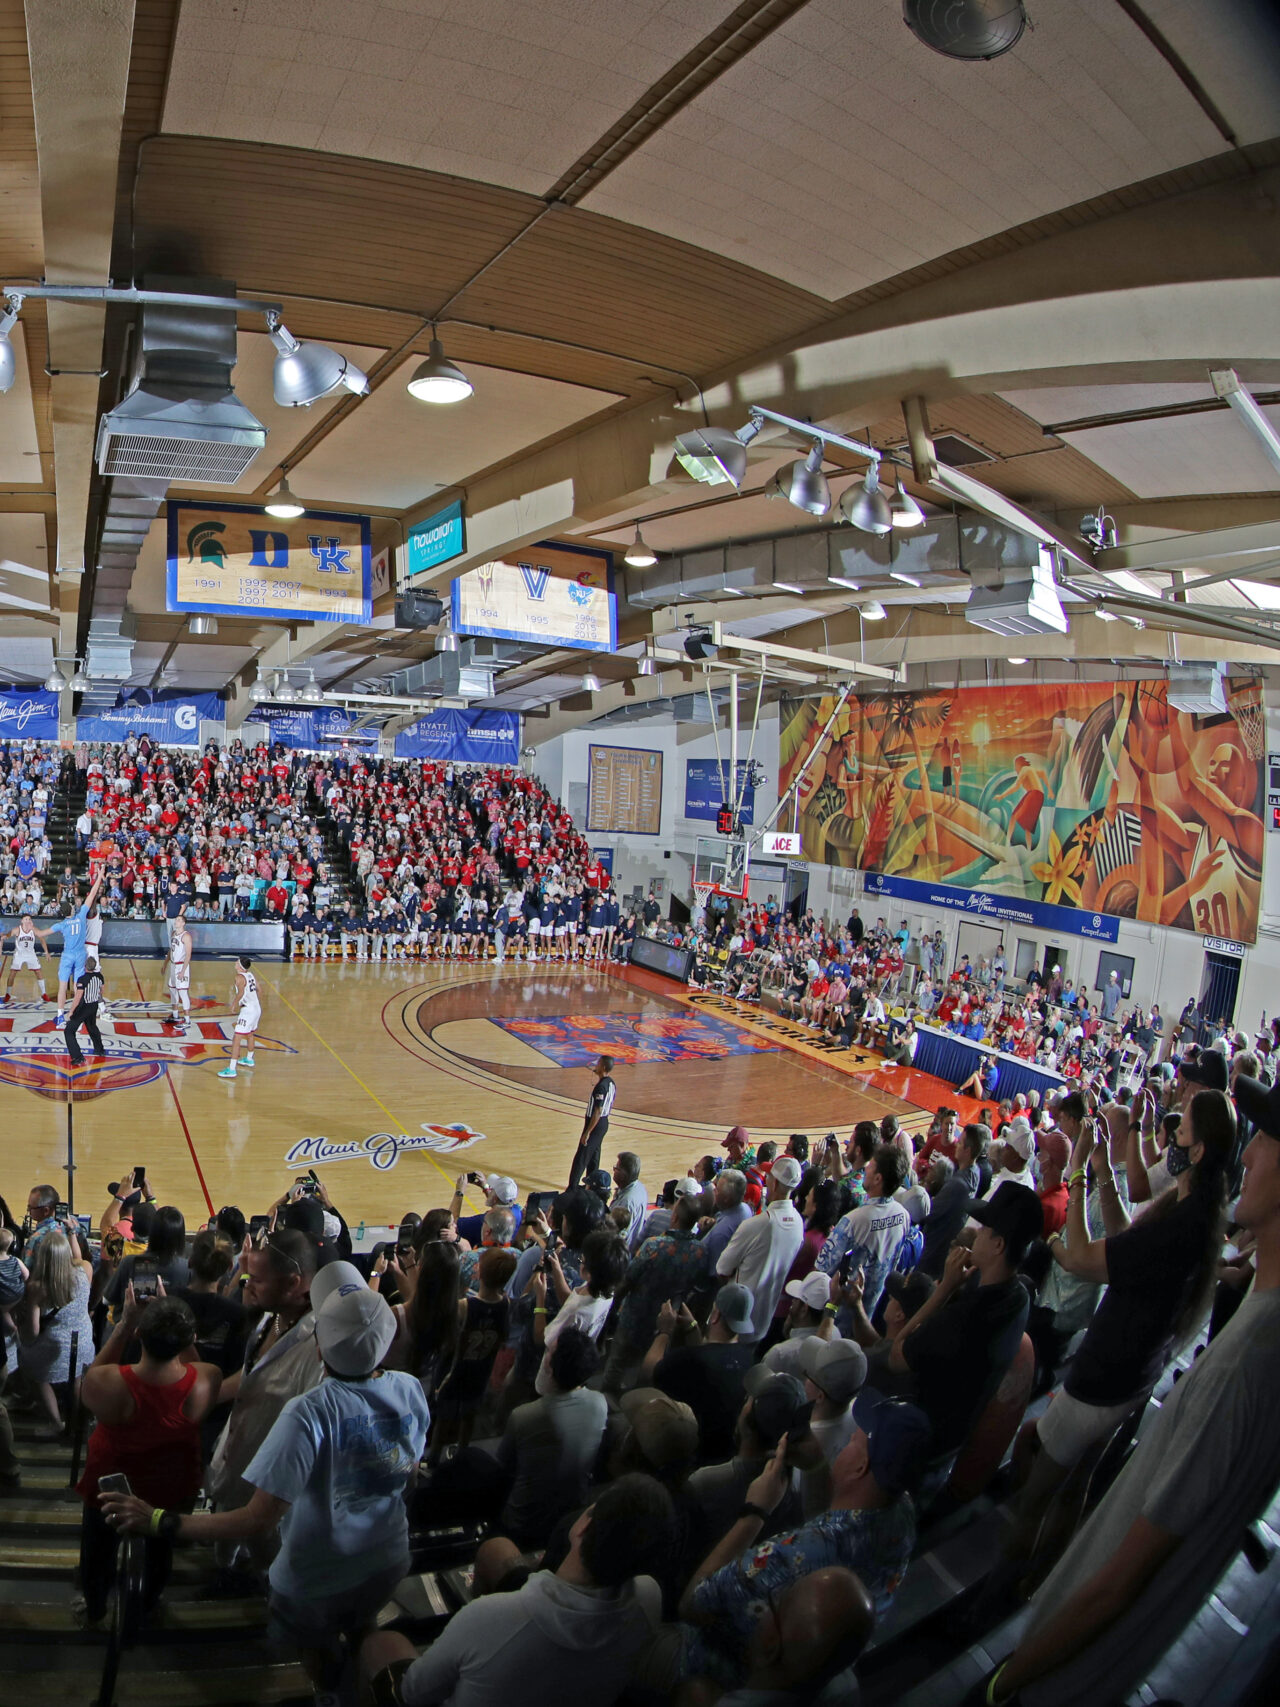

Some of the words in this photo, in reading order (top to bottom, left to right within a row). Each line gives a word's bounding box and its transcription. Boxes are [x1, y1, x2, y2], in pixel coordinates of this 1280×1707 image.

[414, 520, 453, 551] hawaiian
[248, 530, 289, 568] D
[194, 579, 222, 588] 1991
[238, 578, 268, 587] 1992
[272, 580, 302, 590] 2007
[518, 562, 552, 602] V
[239, 587, 267, 597] 1997
[272, 590, 300, 599] 2011
[319, 589, 348, 598] 1993
[237, 596, 266, 605] 2001
[475, 608, 499, 619] 1994
[525, 614, 550, 625] 1995
[574, 622, 598, 632] 2015
[574, 631, 598, 641] 2019
[18, 699, 52, 731] Jim
[100, 712, 132, 725] Tommy
[131, 714, 168, 724] Bahama
[313, 724, 358, 733] SHERATO
[420, 722, 448, 731] HYATT
[467, 727, 497, 736] hmsa
[420, 730, 457, 738] REGENCY
[771, 837, 792, 851] ACE
[790, 860, 808, 869] HOME
[930, 895, 945, 903] HOME
[997, 907, 1034, 920] INVITATIONAL
[1196, 892, 1231, 938] 30
[71, 923, 80, 936] 11
[24, 941, 30, 949] 3
[1206, 936, 1244, 952] VISITOR
[5, 1047, 134, 1057] CHAMNDE
[288, 1137, 358, 1161] Maui
[365, 1133, 440, 1170] Jim
[870, 1203, 905, 1222] BLUEJAYS
